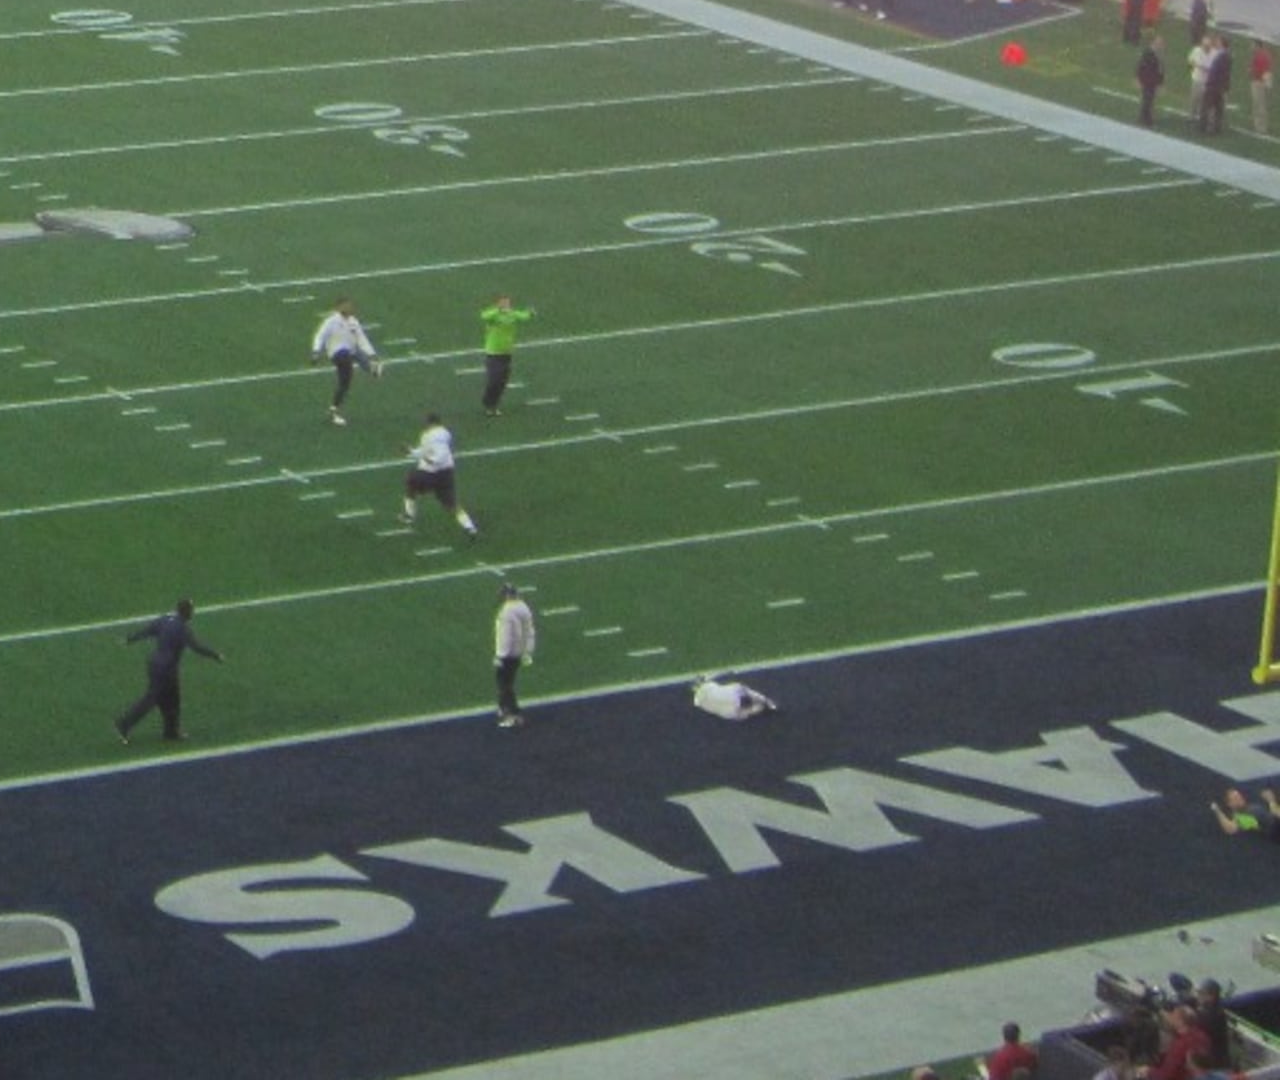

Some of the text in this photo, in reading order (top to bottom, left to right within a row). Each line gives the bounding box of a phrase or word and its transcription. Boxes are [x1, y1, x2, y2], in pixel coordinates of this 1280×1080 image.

[313, 101, 472, 146] 30
[623, 211, 809, 264] 20
[991, 342, 1190, 398] 10
